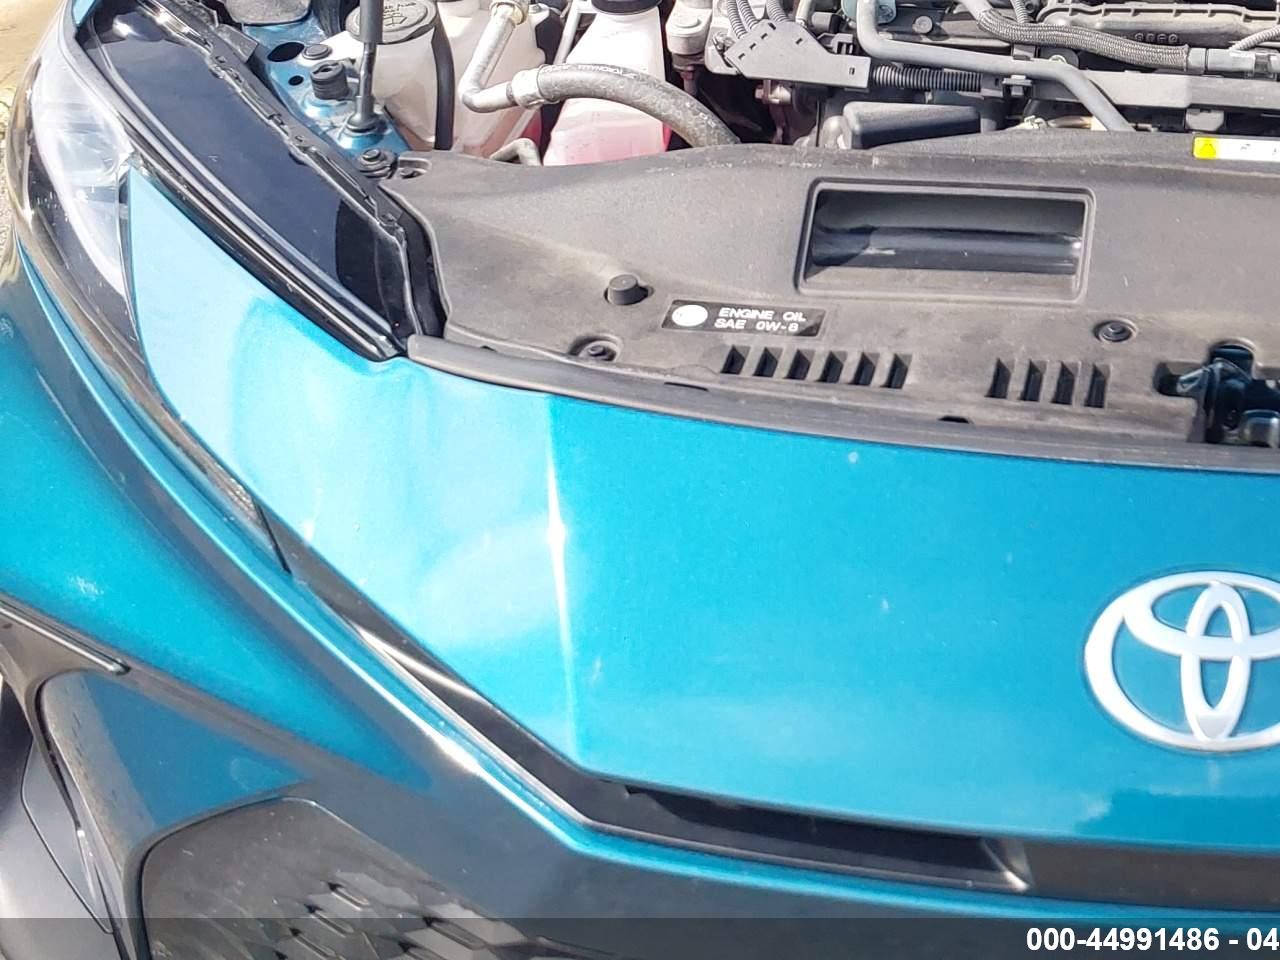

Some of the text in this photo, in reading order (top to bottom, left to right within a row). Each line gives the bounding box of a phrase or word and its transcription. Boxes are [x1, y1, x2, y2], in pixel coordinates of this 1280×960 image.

[718, 307, 807, 323] ENGINE OIL
[714, 318, 747, 330] SAE
